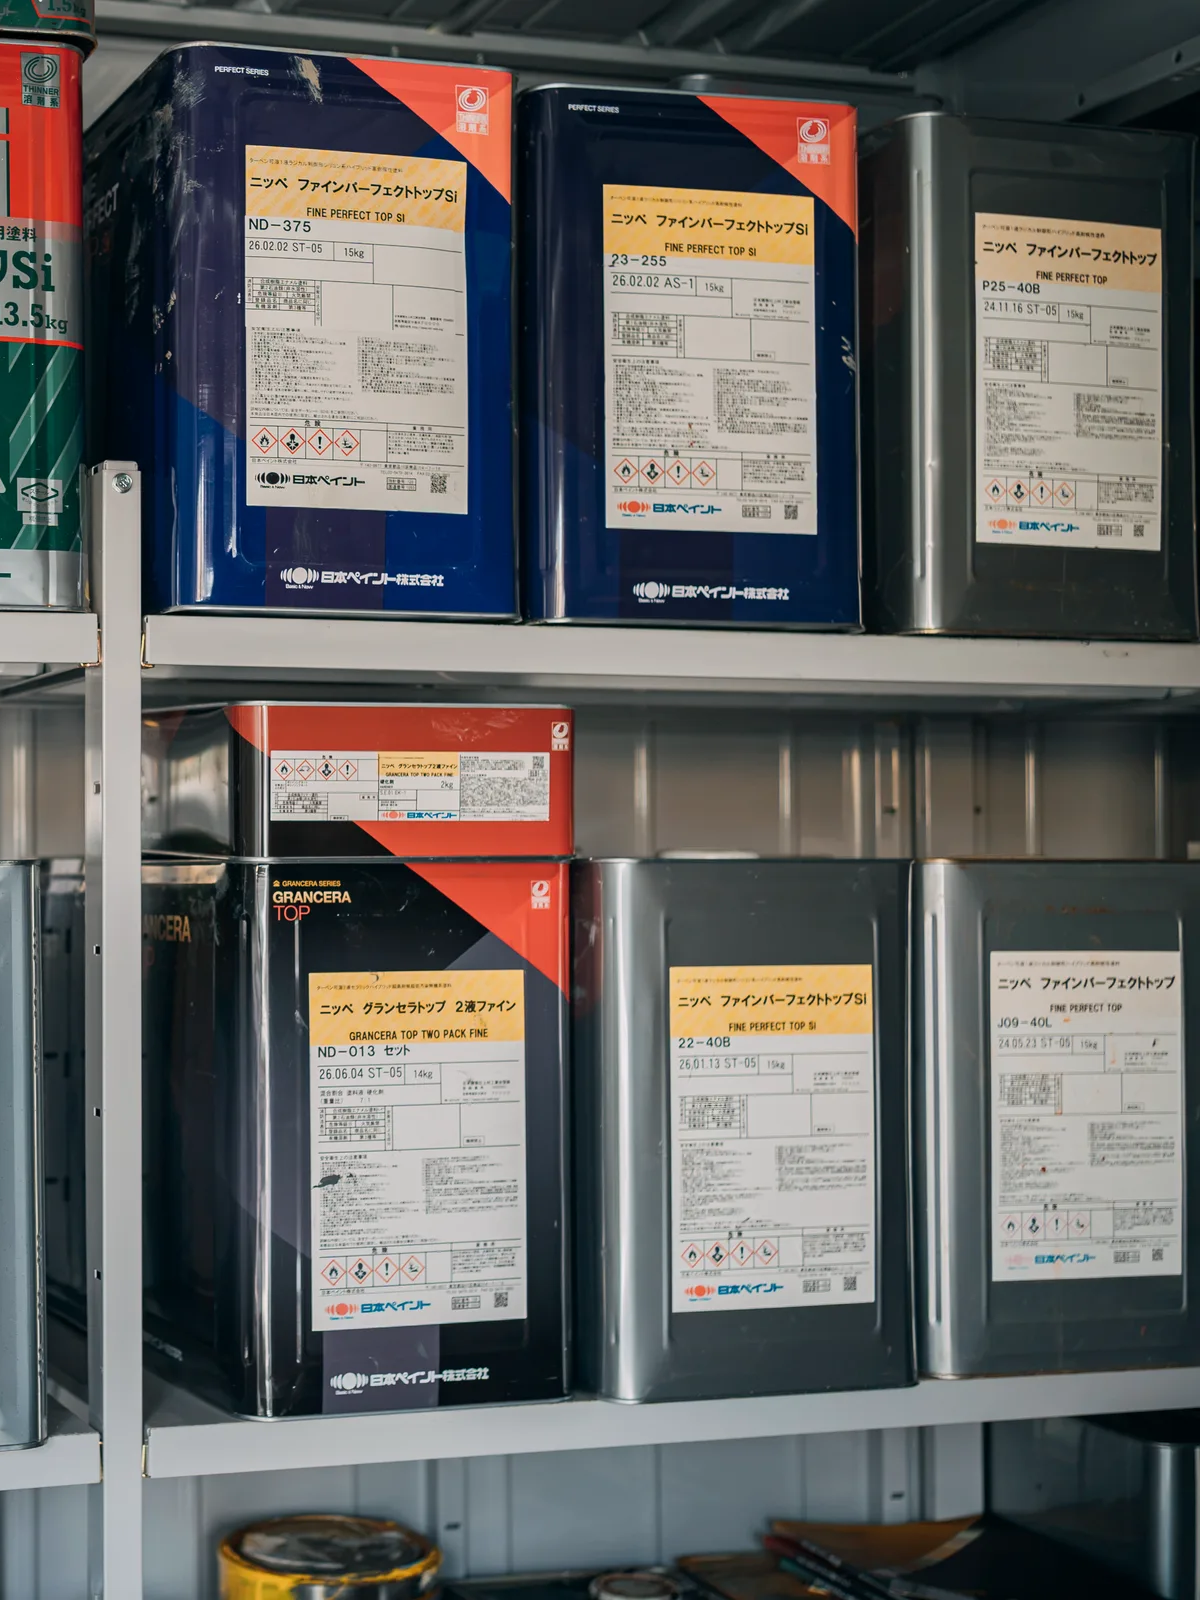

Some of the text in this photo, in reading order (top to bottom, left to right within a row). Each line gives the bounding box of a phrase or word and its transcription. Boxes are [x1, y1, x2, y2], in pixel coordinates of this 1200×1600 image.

[214, 66, 269, 76] PERFECT SERIES
[23, 85, 59, 96] THINNER
[23, 95, 59, 108] 溶剤系
[597, 106, 619, 114] SERIES
[250, 177, 288, 189] ニッペ
[307, 207, 404, 222] FINE PERFECT TOP SI
[612, 213, 647, 225] ニッペ
[249, 219, 311, 232] ND-375
[249, 241, 322, 253] 26.02.02 ST-05
[344, 248, 364, 258] 15kg
[665, 243, 683, 252] FINE
[687, 244, 725, 255] PERFECT
[729, 246, 745, 255] TOP
[983, 241, 1017, 253] ニッペ
[612, 254, 667, 266] 23-255
[613, 275, 693, 289] 26.02.02 AS-1
[1036, 271, 1107, 284] FINE PERFECT TOP
[705, 282, 724, 293] 15kg
[983, 281, 1040, 294] P25-40B
[984, 302, 1056, 316] 24.11.16 ST-05
[1067, 310, 1083, 320] 15kg
[293, 475, 365, 486] 日本ペイント
[321, 570, 444, 587] 日本ペイント株式会社
[672, 585, 789, 600] 日本ペイント株式会社
[441, 781, 453, 790] 2kg
[273, 891, 351, 904] GRANCERA
[273, 905, 310, 921] TOP
[998, 978, 1031, 989] ニッペ
[320, 1000, 516, 1014] ニッペ グランセラトップ 2液ファイン
[679, 996, 712, 1008] ニッペ
[1050, 1004, 1122, 1013] FINE PERFECT TOP
[729, 1023, 746, 1031] FINE
[750, 1022, 785, 1031] PERFECT
[790, 1022, 805, 1030] TOP
[997, 1017, 1052, 1028] J09-40L
[349, 1029, 488, 1040] GRANCERA TOP TWO PACK FINE
[679, 1037, 731, 1049] 22-40B
[999, 1038, 1070, 1049] 24.05.23 ST-05
[1081, 1041, 1097, 1050] 15kg
[318, 1045, 410, 1058] ND-013 セット
[679, 1058, 756, 1070] 26.01.13 ST-05
[767, 1061, 785, 1069] 15kg
[319, 1067, 402, 1079] 26.06.04 ST-05
[414, 1069, 433, 1079] 14kg
[361, 1301, 431, 1313] 日本ペイント
[370, 1367, 489, 1386] 日本ペイント株式会社
